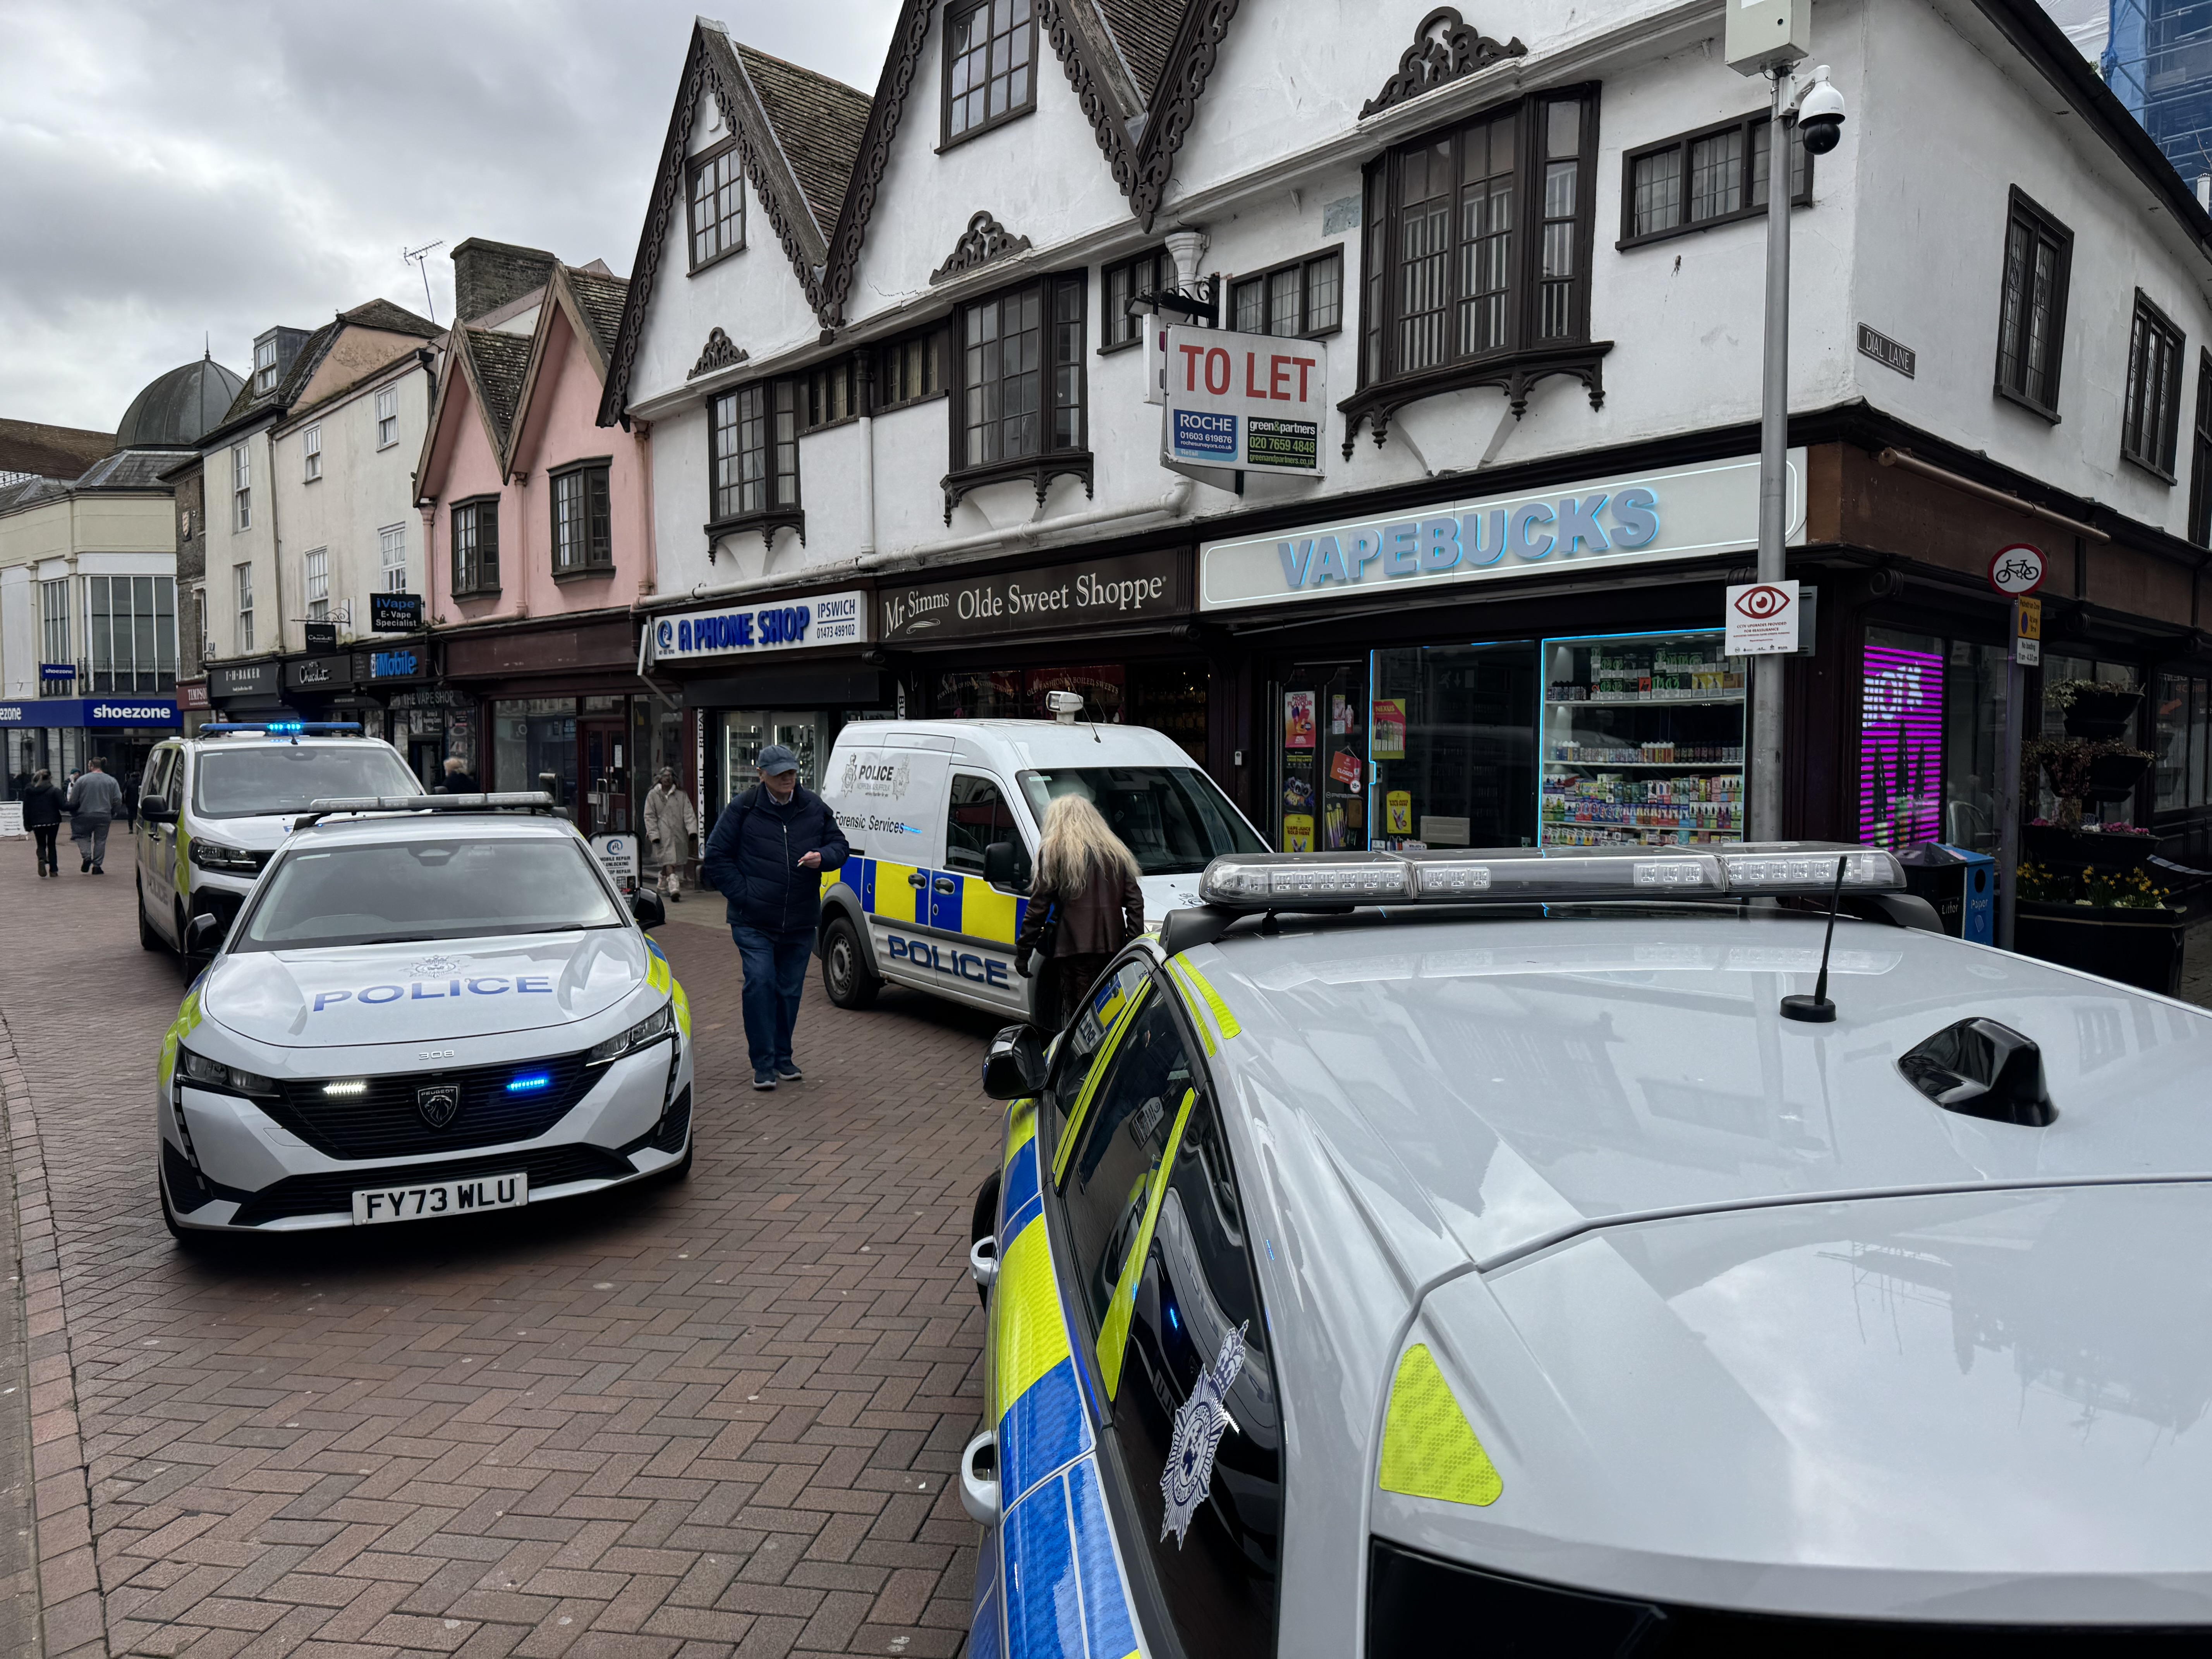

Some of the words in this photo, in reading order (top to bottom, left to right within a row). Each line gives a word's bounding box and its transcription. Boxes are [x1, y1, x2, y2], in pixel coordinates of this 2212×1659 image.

[1867, 331, 1884, 358] DIAL
[1889, 343, 1909, 370] LANE
[1179, 344, 1231, 395] TO
[1246, 352, 1316, 403] LET
[1180, 414, 1232, 432] ROCHE
[1250, 419, 1315, 435] green&partners
[1180, 431, 1203, 441] 01603
[1205, 433, 1232, 444] 619876
[1181, 440, 1232, 450] rochesurveyors.co.uk
[1250, 436, 1266, 449] 020
[1269, 438, 1291, 451] 7659
[1293, 440, 1315, 453] 4848
[1181, 449, 1199, 457] Retail
[1249, 454, 1315, 466] greenandpartners.co.uk
[1278, 488, 1658, 586] VAPEBUCKS
[376, 598, 415, 610] iVape
[958, 587, 1003, 620] Olde
[1008, 584, 1069, 614] Sweet
[1076, 572, 1163, 610] Shoppe
[391, 611, 411, 620] Vape
[817, 599, 855, 619] IPSWICH
[885, 596, 905, 638] Mr
[908, 590, 950, 618] Simms
[376, 619, 417, 628] Specialist
[678, 619, 692, 652] A
[694, 612, 754, 651] PHONE
[757, 605, 810, 645] SHOP
[817, 626, 833, 639] 01473
[835, 623, 855, 637] 499102
[376, 651, 417, 677] iMobile
[1073, 677, 1095, 687] BOILED
[1096, 680, 1119, 694] SWEETS
[404, 693, 416, 706] THE
[417, 691, 434, 705] VAPE
[435, 690, 454, 704] SHOP
[93, 705, 171, 720] shoezone
[859, 765, 894, 781] POLICE
[835, 811, 866, 829] Forensic
[869, 815, 905, 834] Services
[1942, 900, 1958, 915] Litter
[1971, 899, 1988, 910] Paper
[888, 934, 1010, 991] POLICE
[313, 976, 553, 1012] POLICE
[419, 1050, 454, 1060] 308
[367, 1188, 447, 1219] FY73
[457, 1178, 515, 1209] WLU
